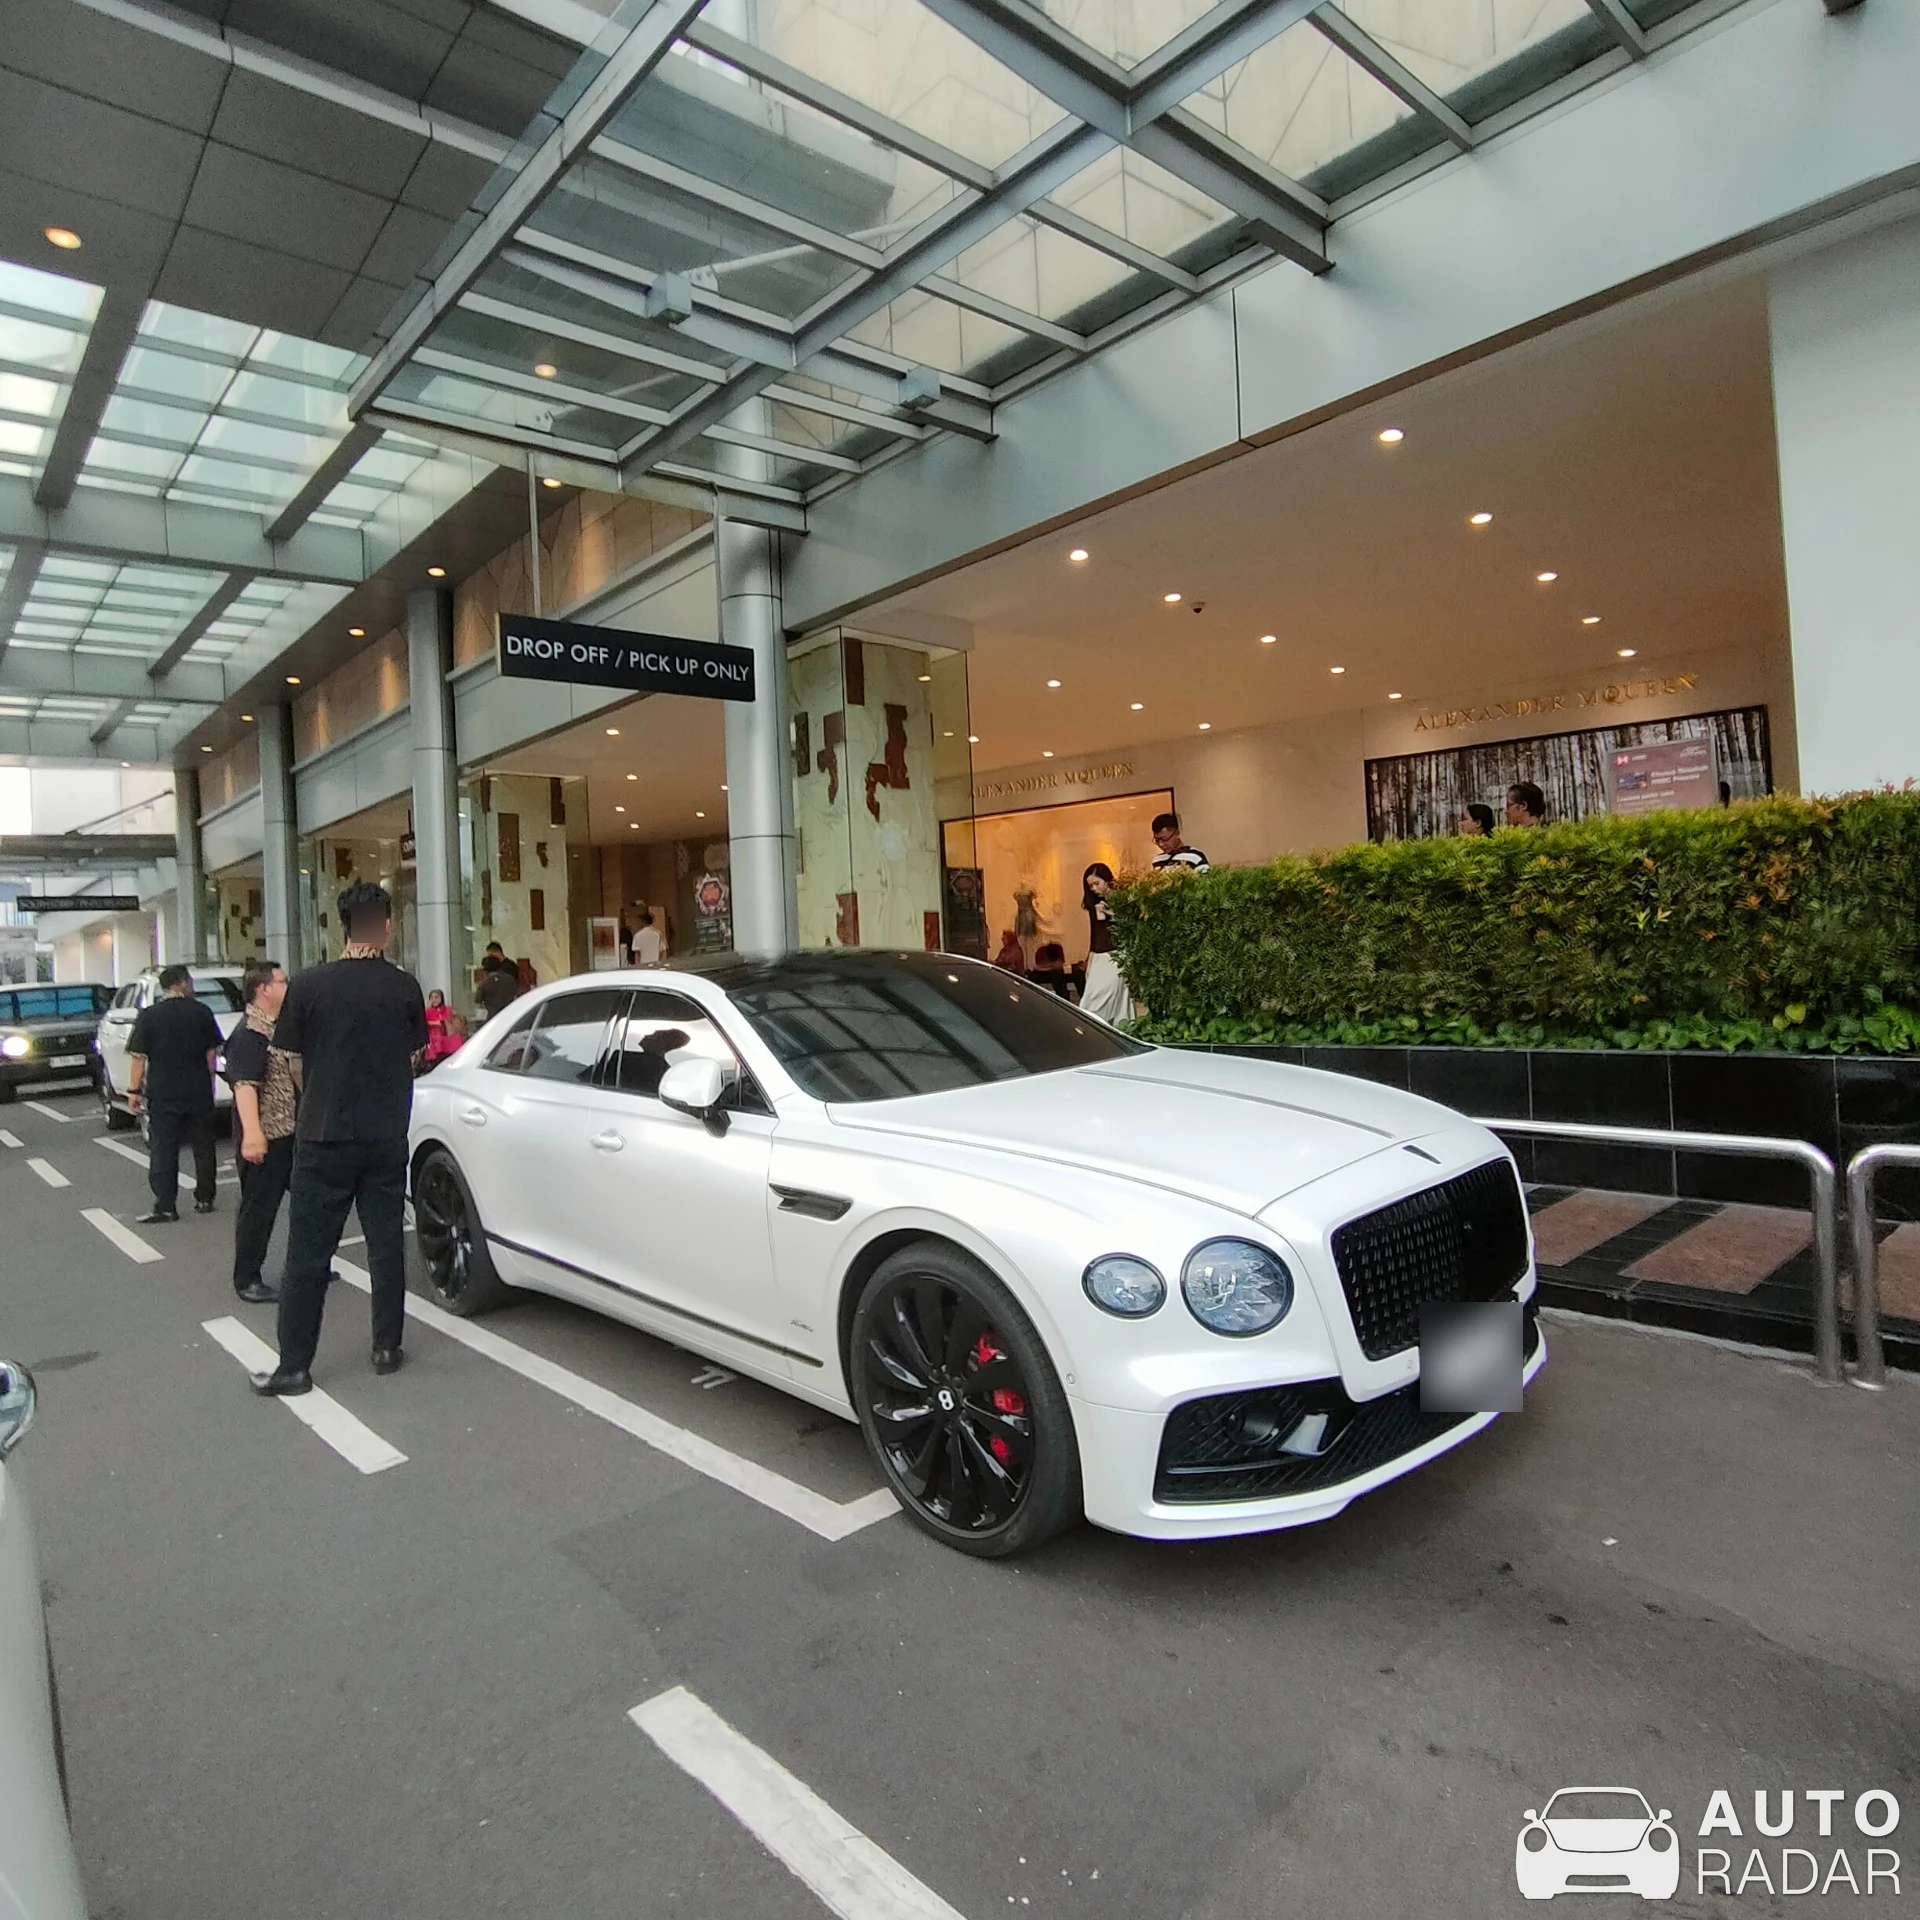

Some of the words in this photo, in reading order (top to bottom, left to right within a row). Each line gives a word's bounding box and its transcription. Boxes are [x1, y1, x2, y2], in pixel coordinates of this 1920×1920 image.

[506, 635, 564, 660] DROP
[570, 644, 610, 666] OFF
[614, 649, 623, 669] /
[629, 650, 671, 674] PICK
[675, 656, 699, 676] UP
[703, 661, 749, 682] ONLY
[1413, 695, 1568, 732] ALEXANDER
